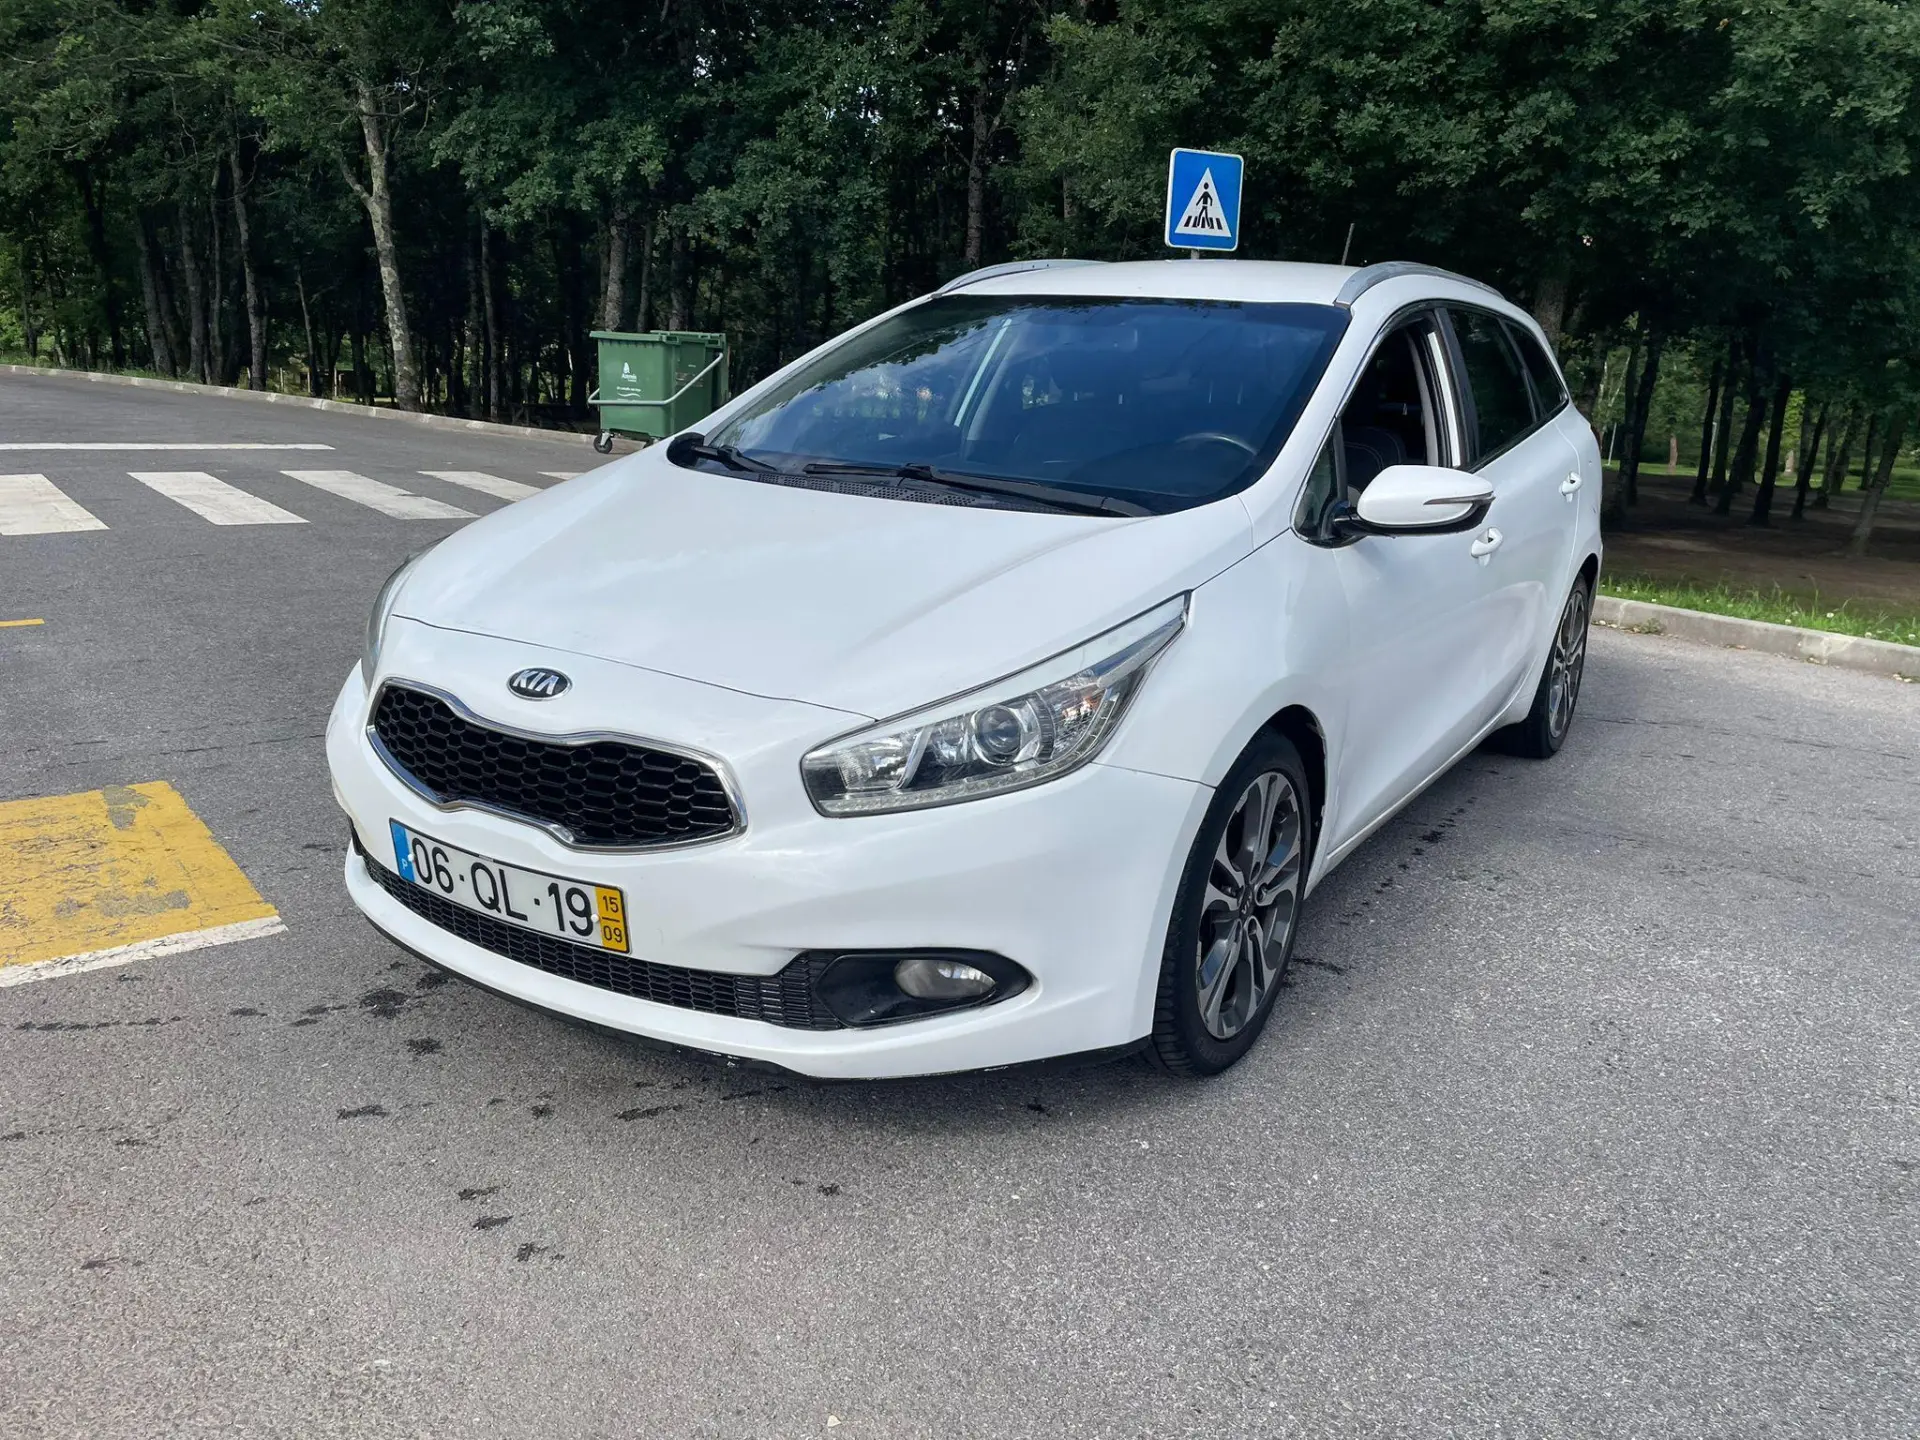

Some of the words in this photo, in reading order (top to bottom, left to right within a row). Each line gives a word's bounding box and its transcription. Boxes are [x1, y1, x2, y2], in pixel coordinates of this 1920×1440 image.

[512, 670, 559, 695] KIA
[602, 895, 619, 913] 15
[603, 925, 623, 943] 09
